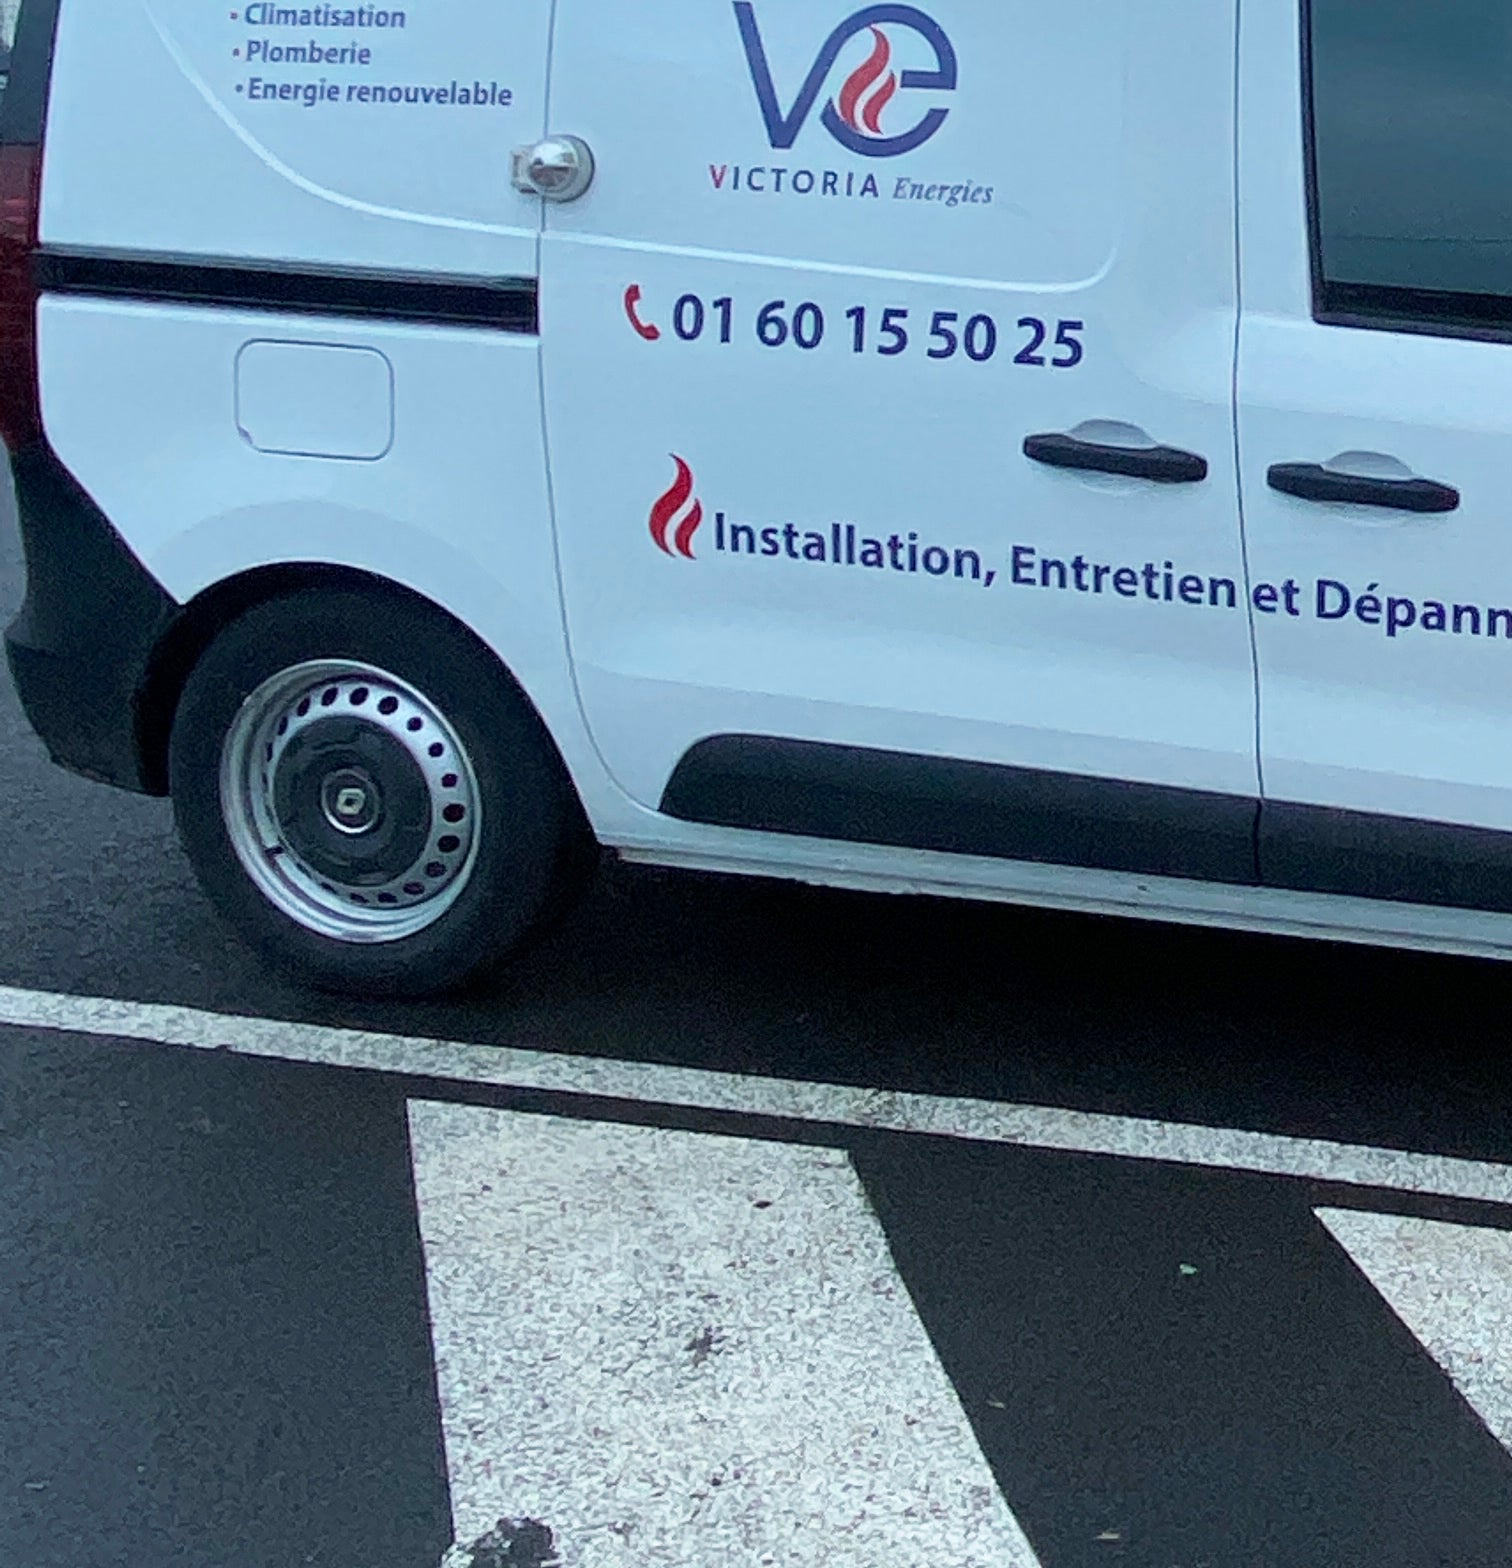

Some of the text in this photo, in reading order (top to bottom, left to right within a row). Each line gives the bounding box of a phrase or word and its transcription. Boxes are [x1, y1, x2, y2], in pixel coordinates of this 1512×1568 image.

[244, 3, 407, 29] Climatisation
[245, 40, 372, 65] Plomberie
[248, 78, 514, 107] Energie renouvelable
[709, 164, 994, 207] VICTORIA Energies
[673, 293, 1085, 368] 01 60 15 50 25
[714, 512, 997, 589] Installation,
[1011, 545, 1236, 608] Entretien
[1252, 578, 1301, 616] et
